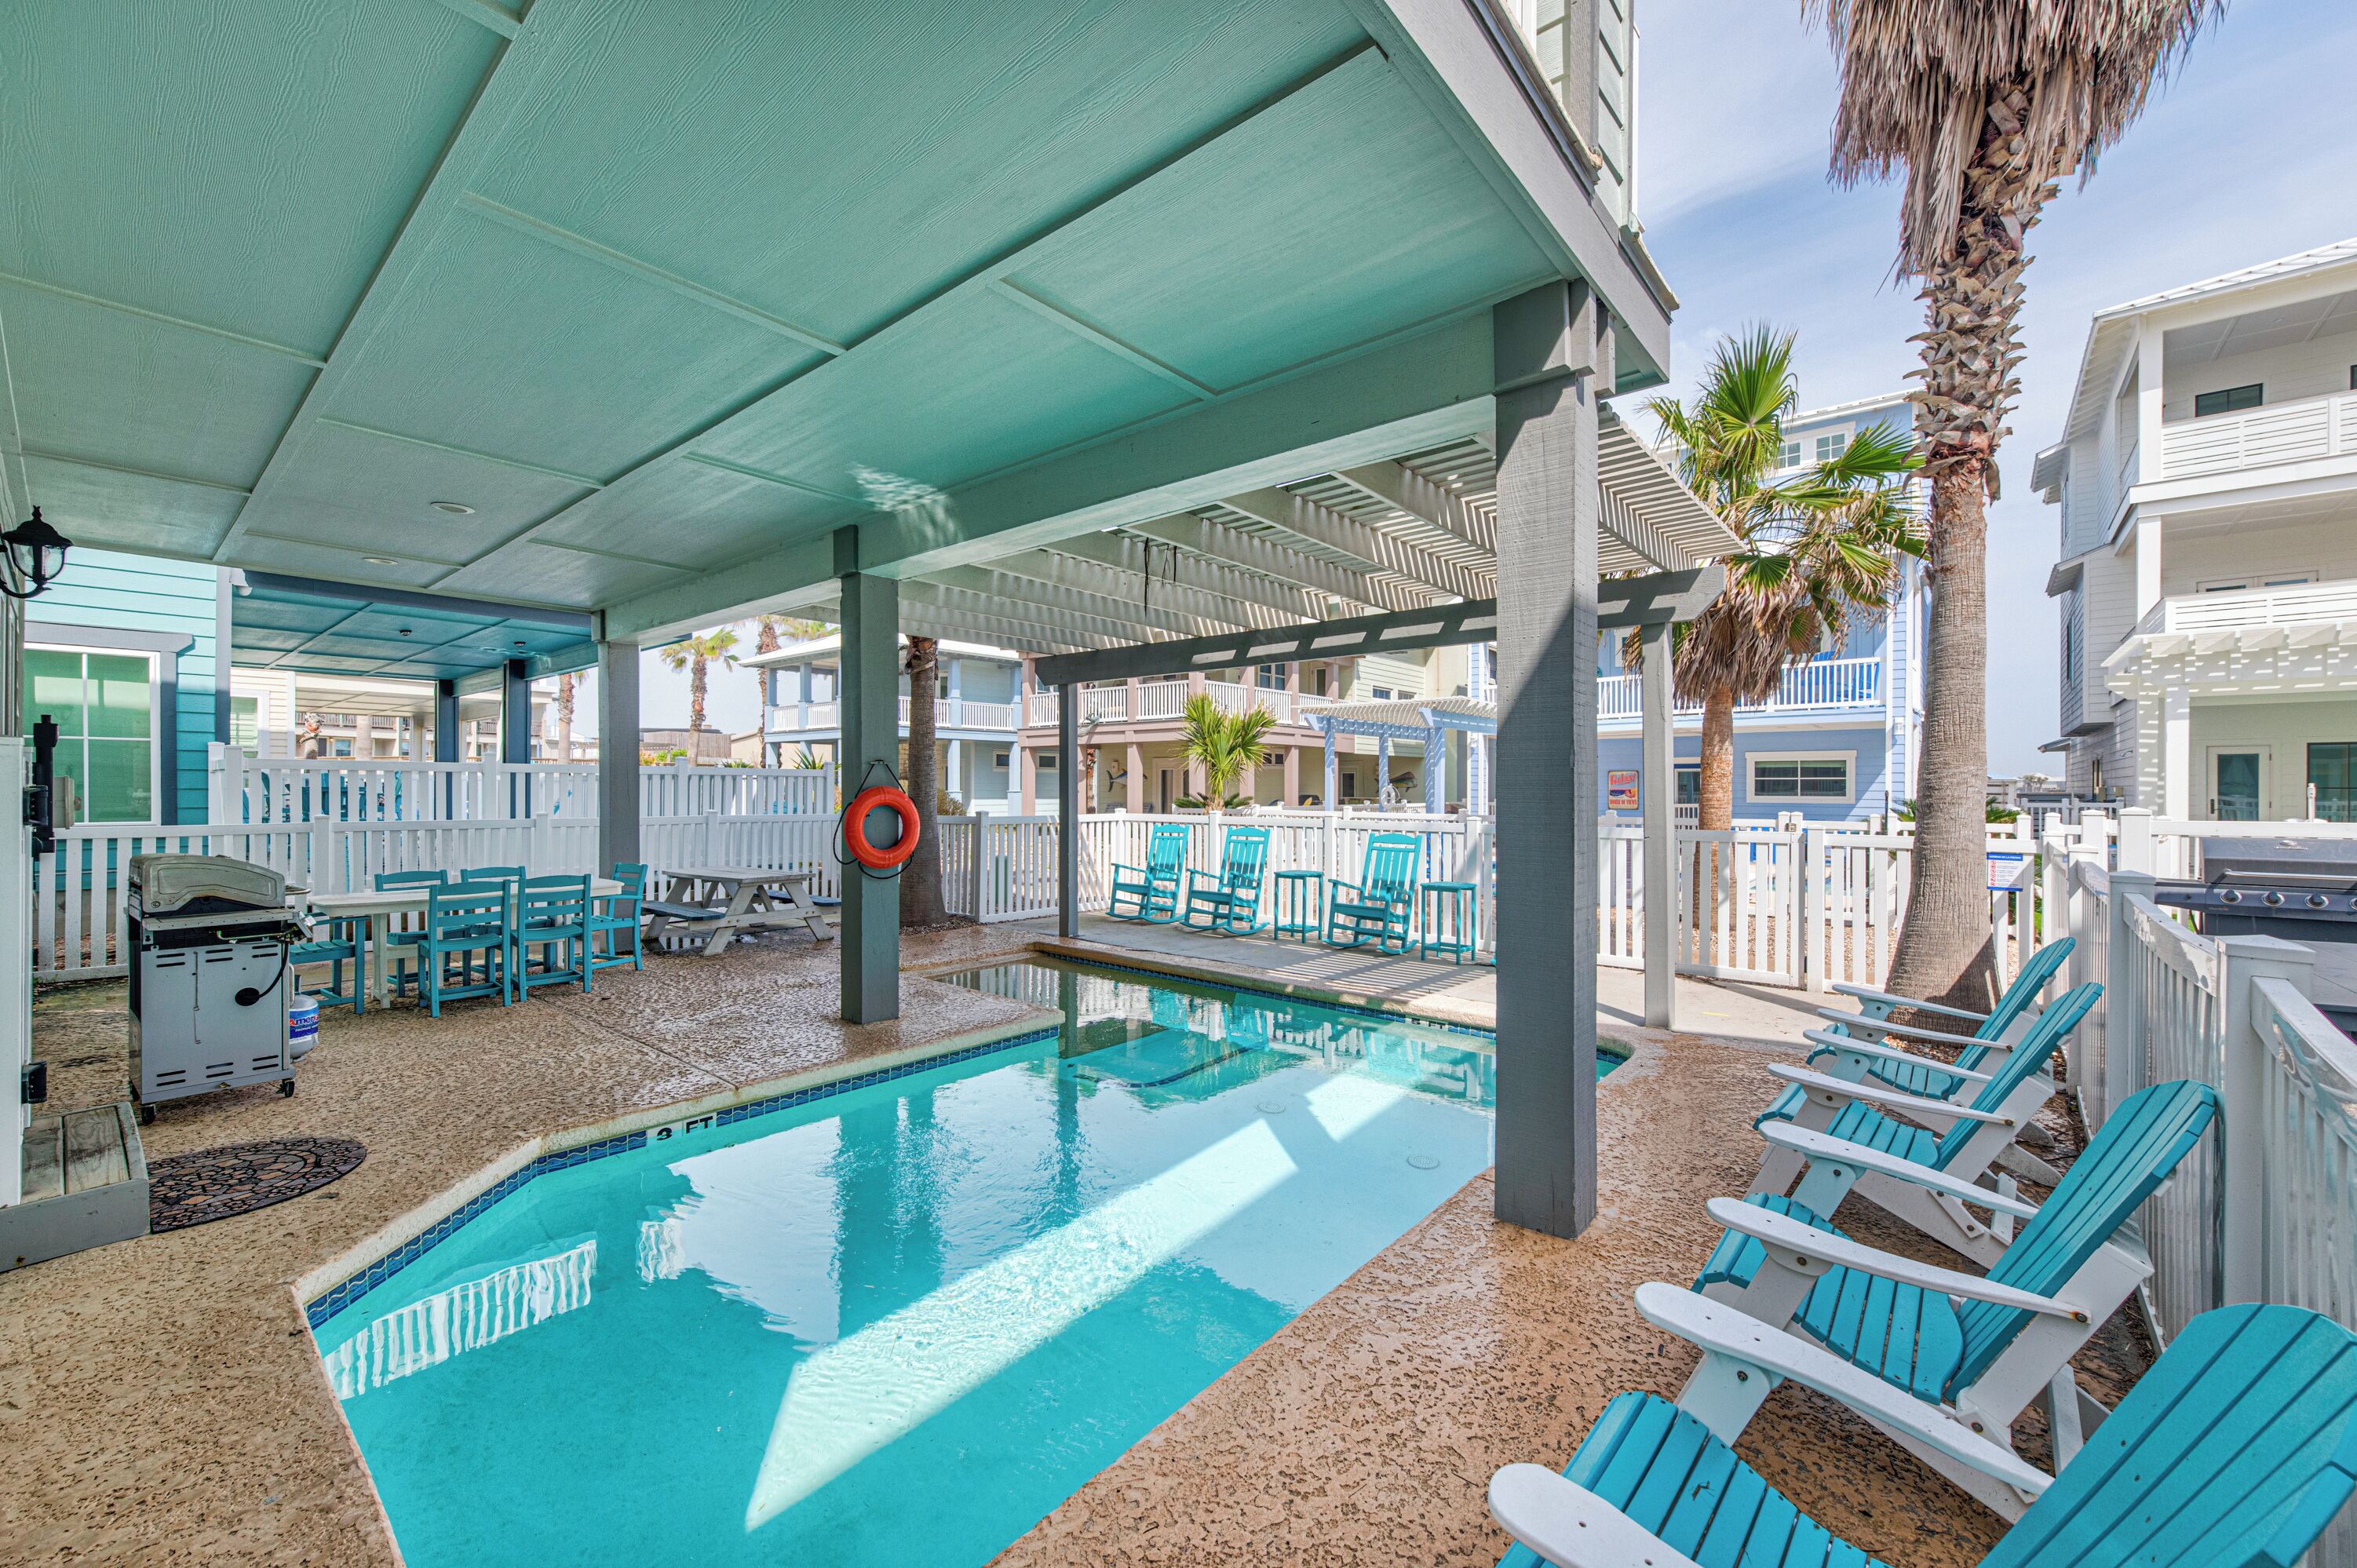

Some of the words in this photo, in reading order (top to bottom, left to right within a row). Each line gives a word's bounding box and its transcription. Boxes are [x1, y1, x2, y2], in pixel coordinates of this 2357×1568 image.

[1428, 1020, 1446, 1029] FT
[656, 1127, 673, 1141] 3
[685, 1115, 713, 1134] FT
